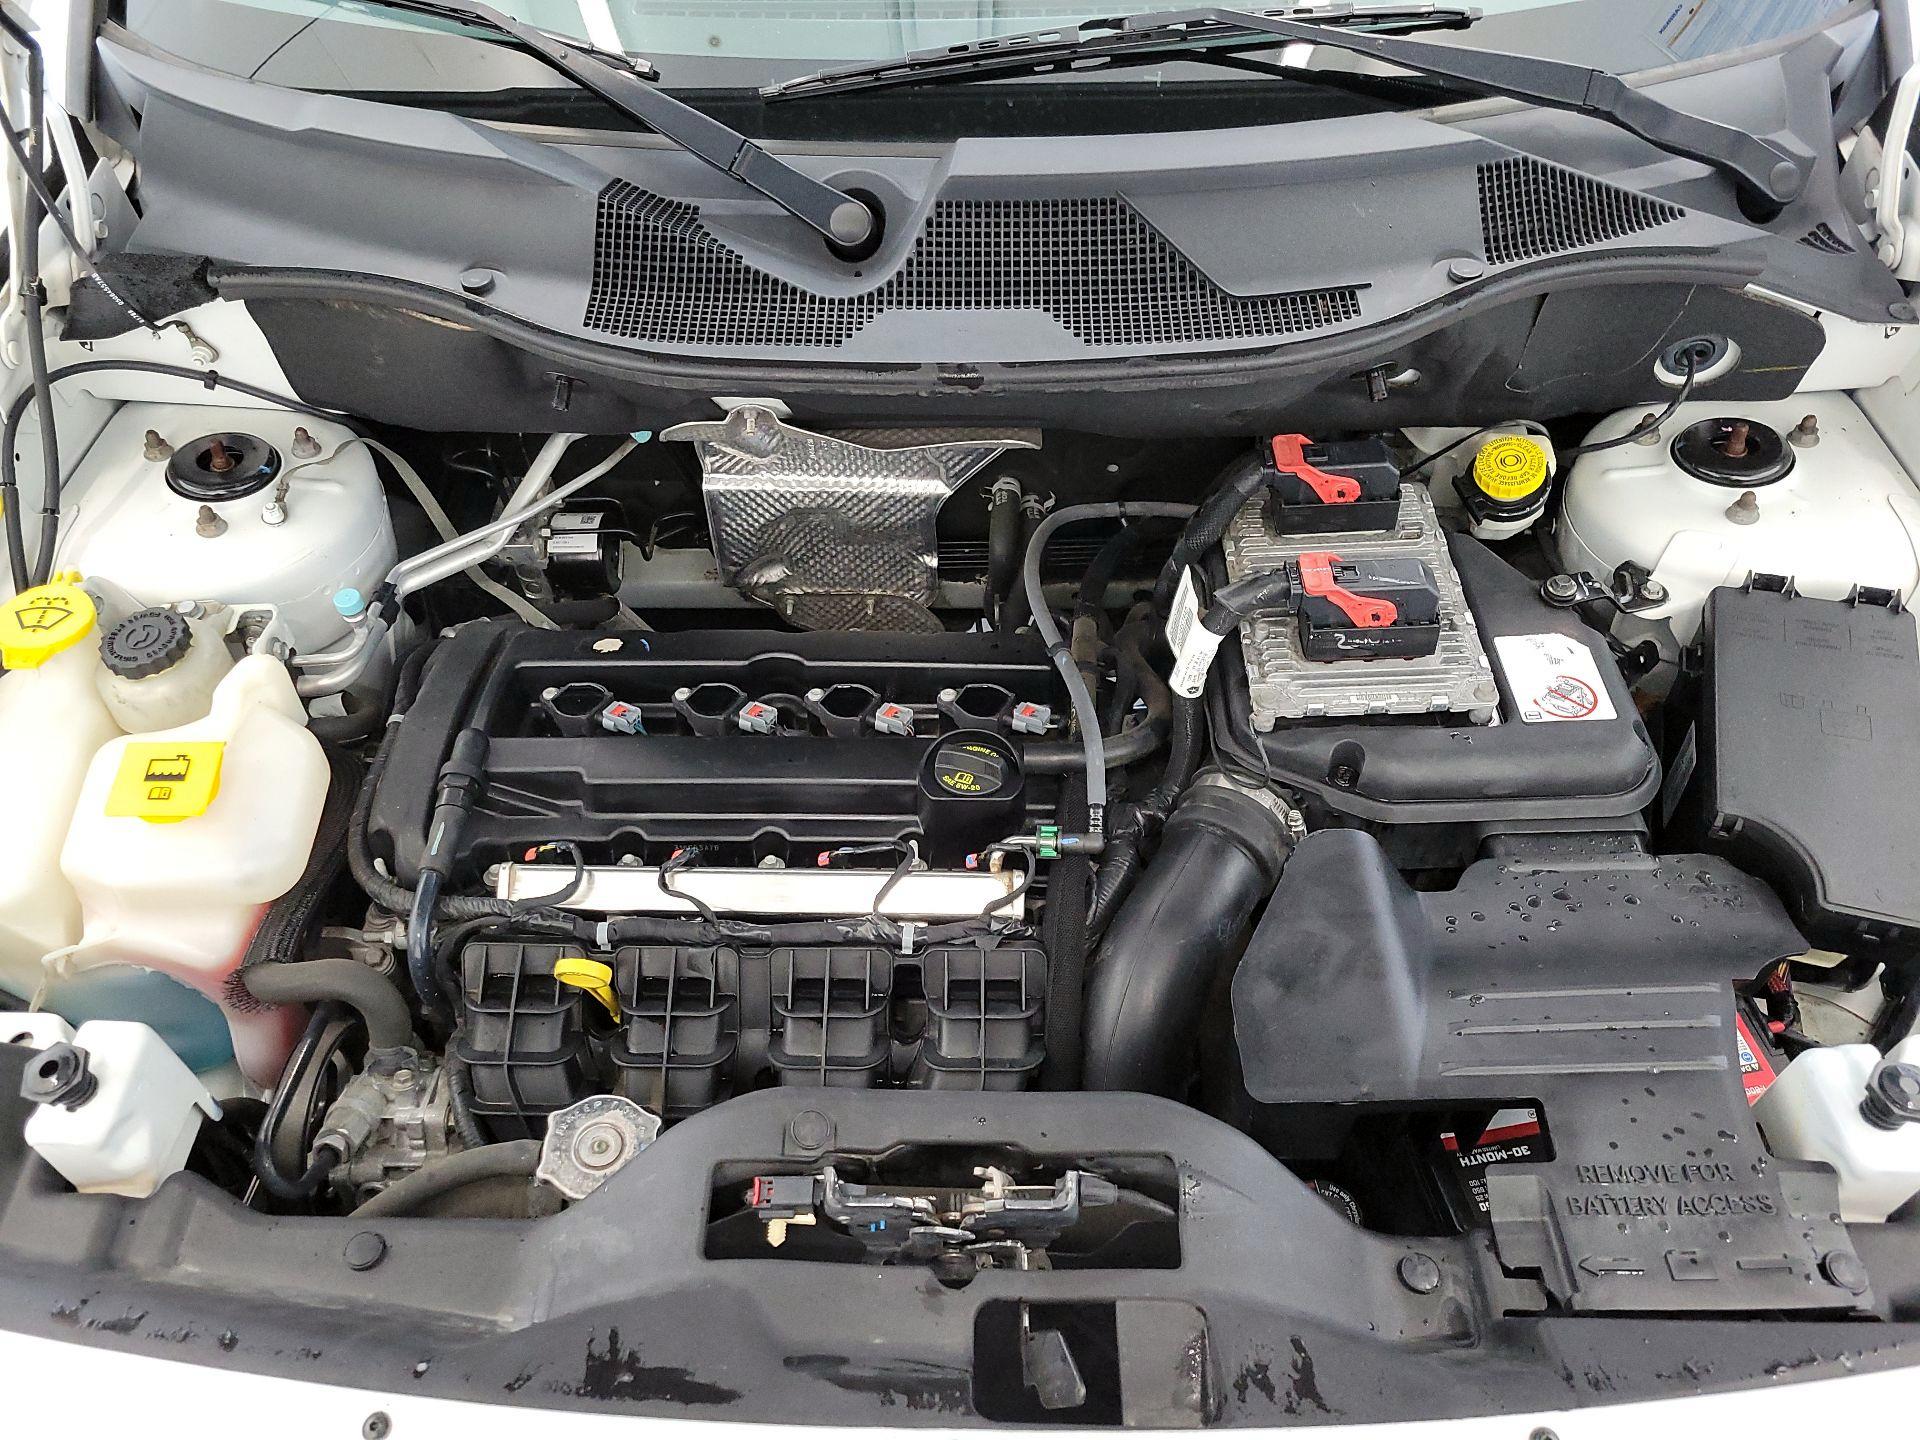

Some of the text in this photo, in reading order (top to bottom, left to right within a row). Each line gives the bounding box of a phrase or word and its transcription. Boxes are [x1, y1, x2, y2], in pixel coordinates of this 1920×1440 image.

[942, 775, 956, 787] SAE
[1459, 1145, 1531, 1168] 30-MONTH
[1576, 1162, 1735, 1184] REMOVE FOR
[1566, 1194, 1777, 1216] BATTERY ACCESS
